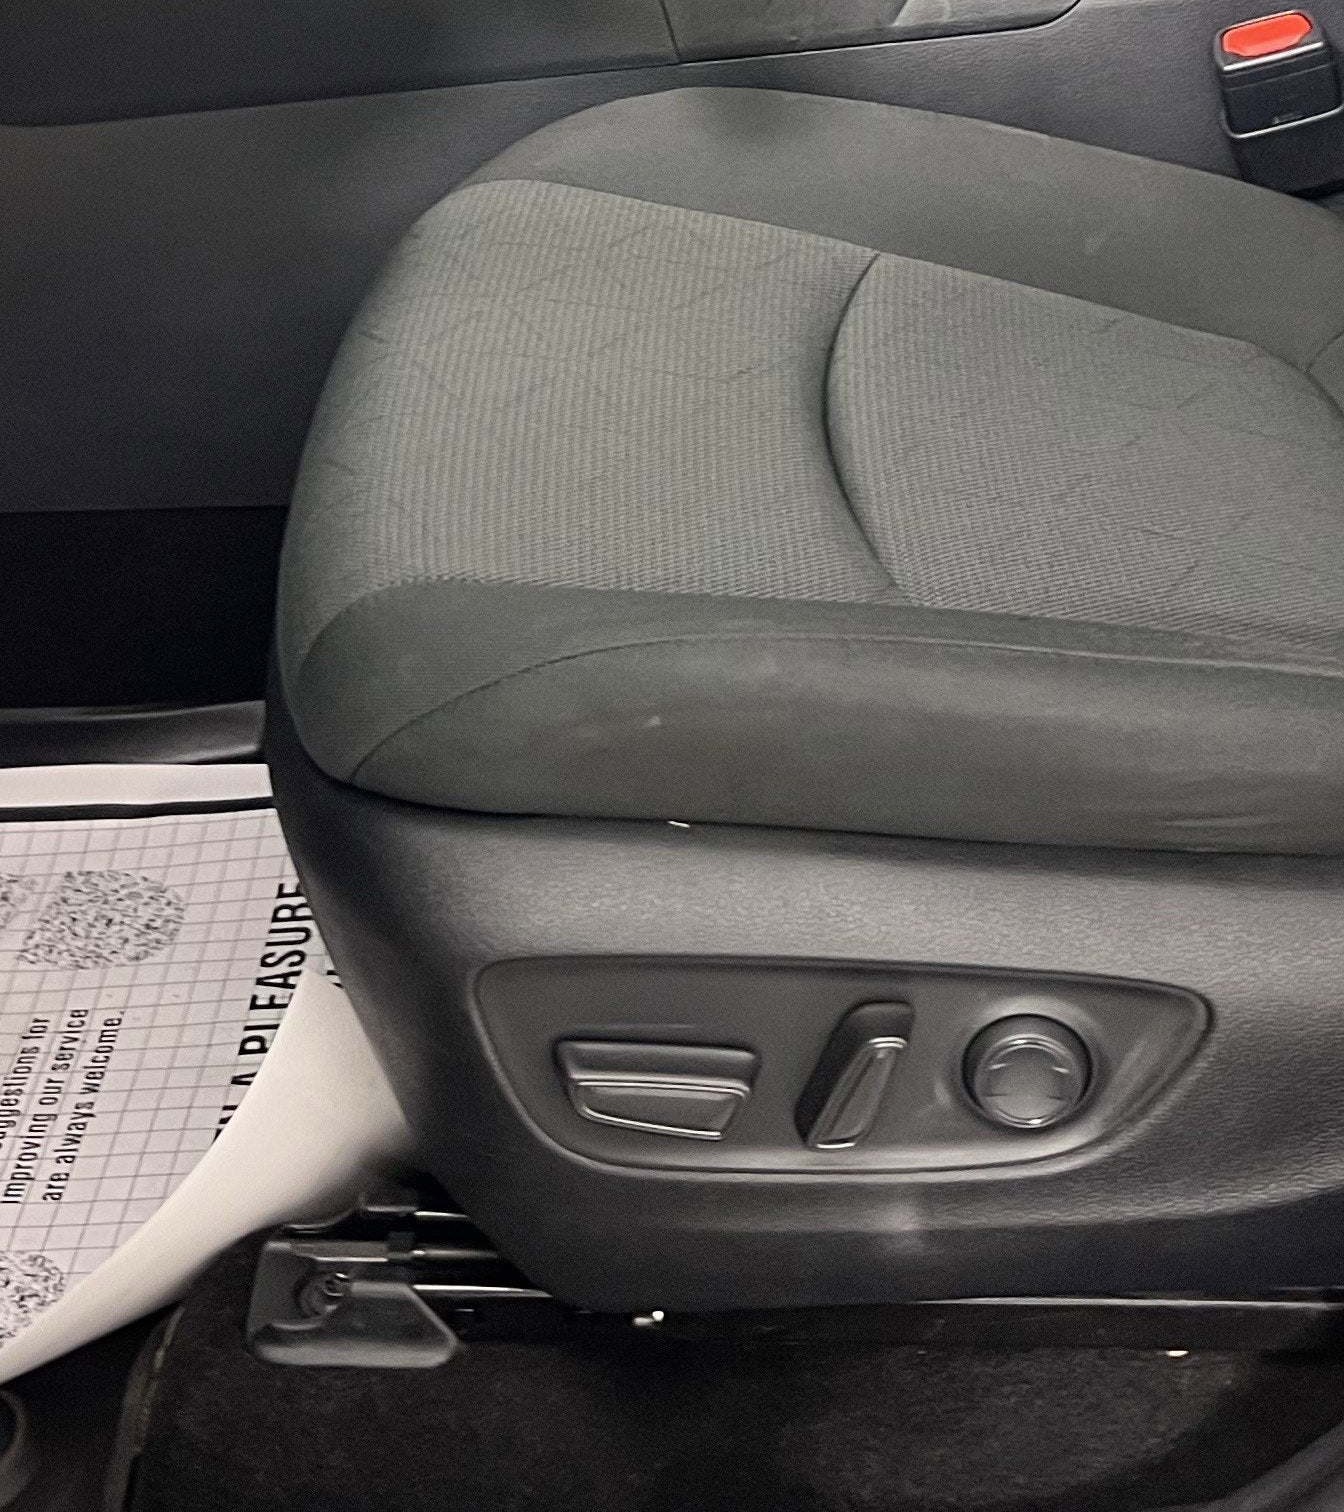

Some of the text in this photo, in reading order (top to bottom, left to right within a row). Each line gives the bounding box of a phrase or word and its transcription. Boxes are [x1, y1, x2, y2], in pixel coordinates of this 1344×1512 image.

[20, 1017, 51, 1040] for
[51, 1008, 90, 1072] service
[38, 1077, 65, 1106] our
[41, 1010, 126, 1202] are always welcome.
